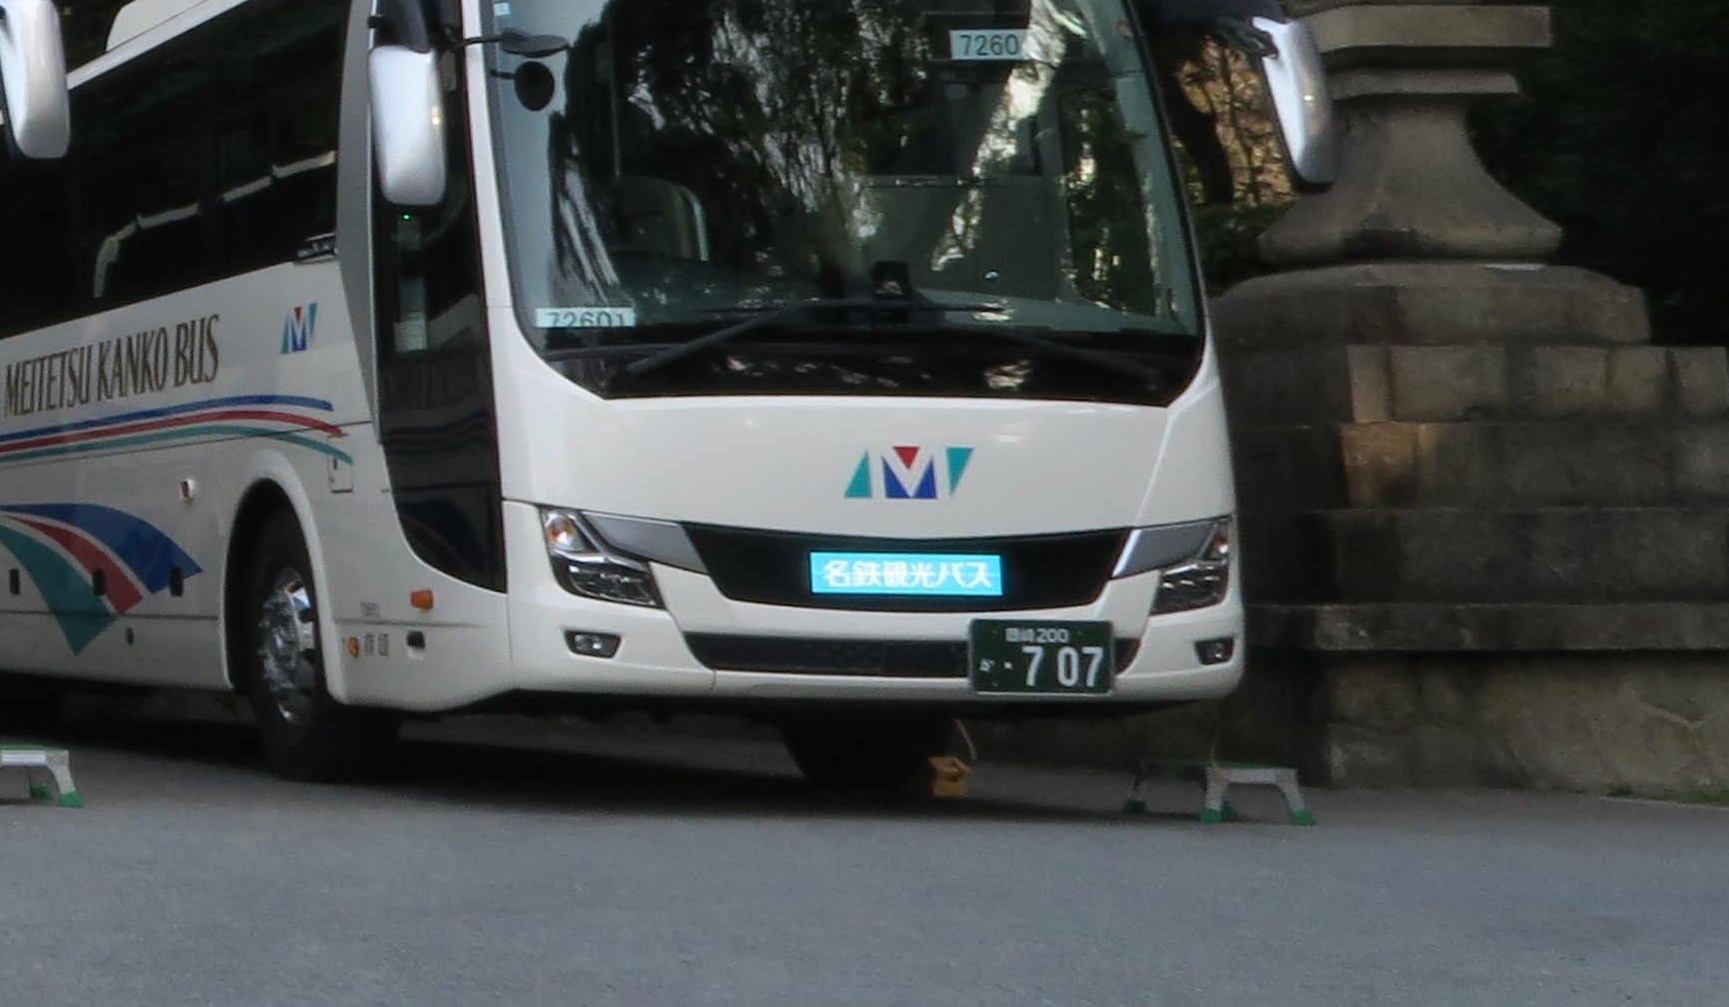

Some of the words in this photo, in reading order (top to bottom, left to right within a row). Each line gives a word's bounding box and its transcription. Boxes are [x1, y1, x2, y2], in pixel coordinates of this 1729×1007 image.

[960, 34, 1019, 56] 7260
[4, 344, 92, 418] MEITETSU
[98, 326, 168, 401] KANKO
[175, 314, 219, 387] BUS
[824, 560, 992, 588] 名鉄観光バス
